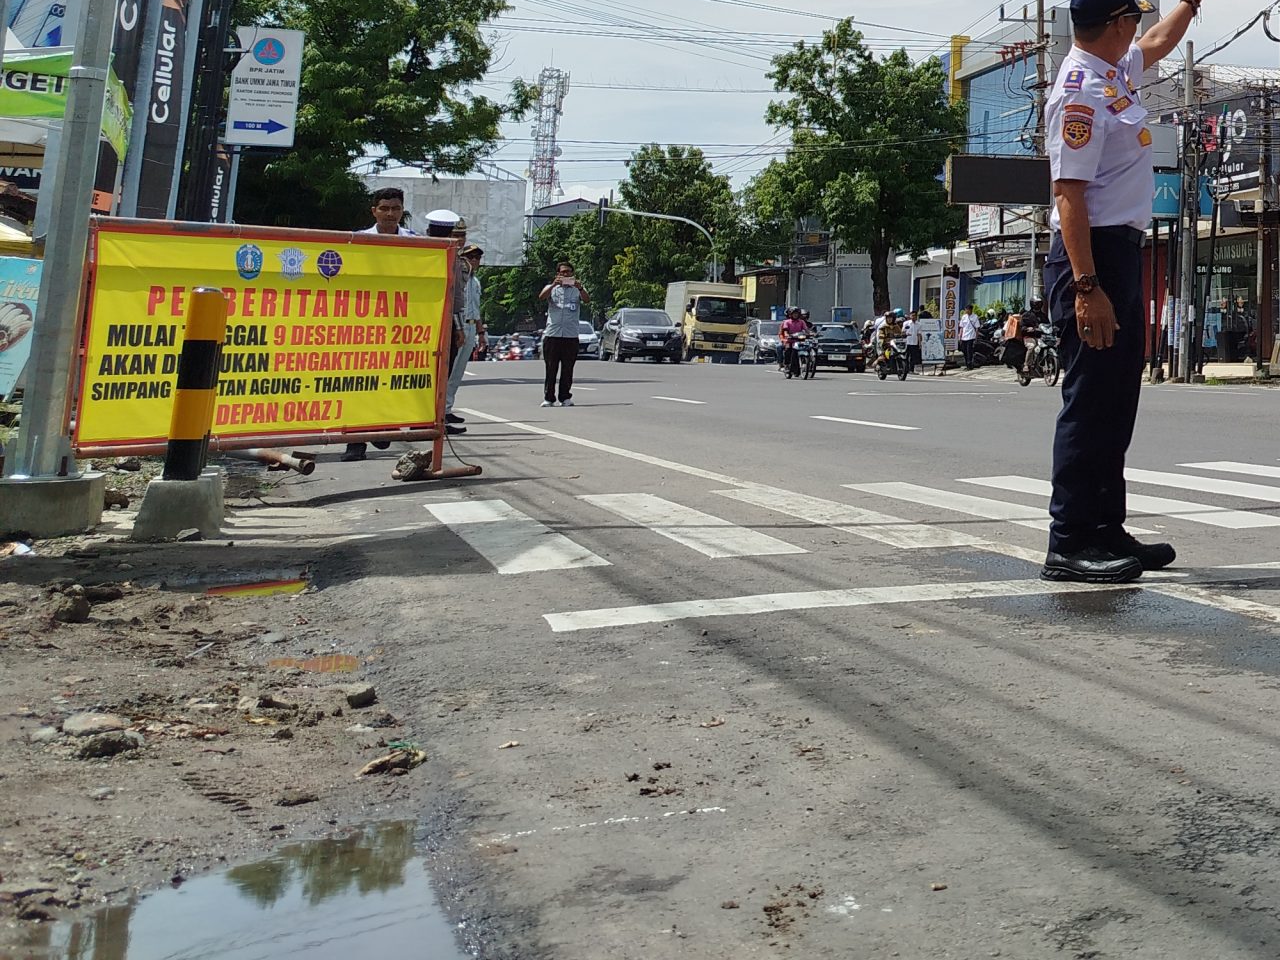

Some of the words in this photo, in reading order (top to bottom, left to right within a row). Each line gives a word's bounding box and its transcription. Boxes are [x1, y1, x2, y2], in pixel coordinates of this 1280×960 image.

[0, 69, 65, 94] GET
[152, 20, 177, 123] Cellular
[234, 77, 249, 85] BANK
[266, 79, 280, 87] JAWA
[280, 80, 296, 88] TIMUR
[209, 167, 224, 223] ellular
[1214, 242, 1253, 261] SAMSUNG
[148, 286, 409, 317] PEBERITAHUAN
[944, 280, 957, 340] PARFUM
[107, 325, 176, 347] MULAI
[274, 325, 286, 345] 9
[291, 325, 386, 345] DESEMBER
[391, 325, 431, 345] 2024
[99, 354, 157, 375] AKAN
[274, 352, 390, 372] PENGAKTIFAN
[393, 351, 430, 369] APILL
[92, 381, 171, 400] SIMPANG
[249, 378, 301, 396] AGUNG
[314, 376, 379, 393] THAMRIN
[390, 374, 432, 390] MENUR
[216, 402, 279, 425] DEPAN
[284, 400, 332, 422] OKAZ
